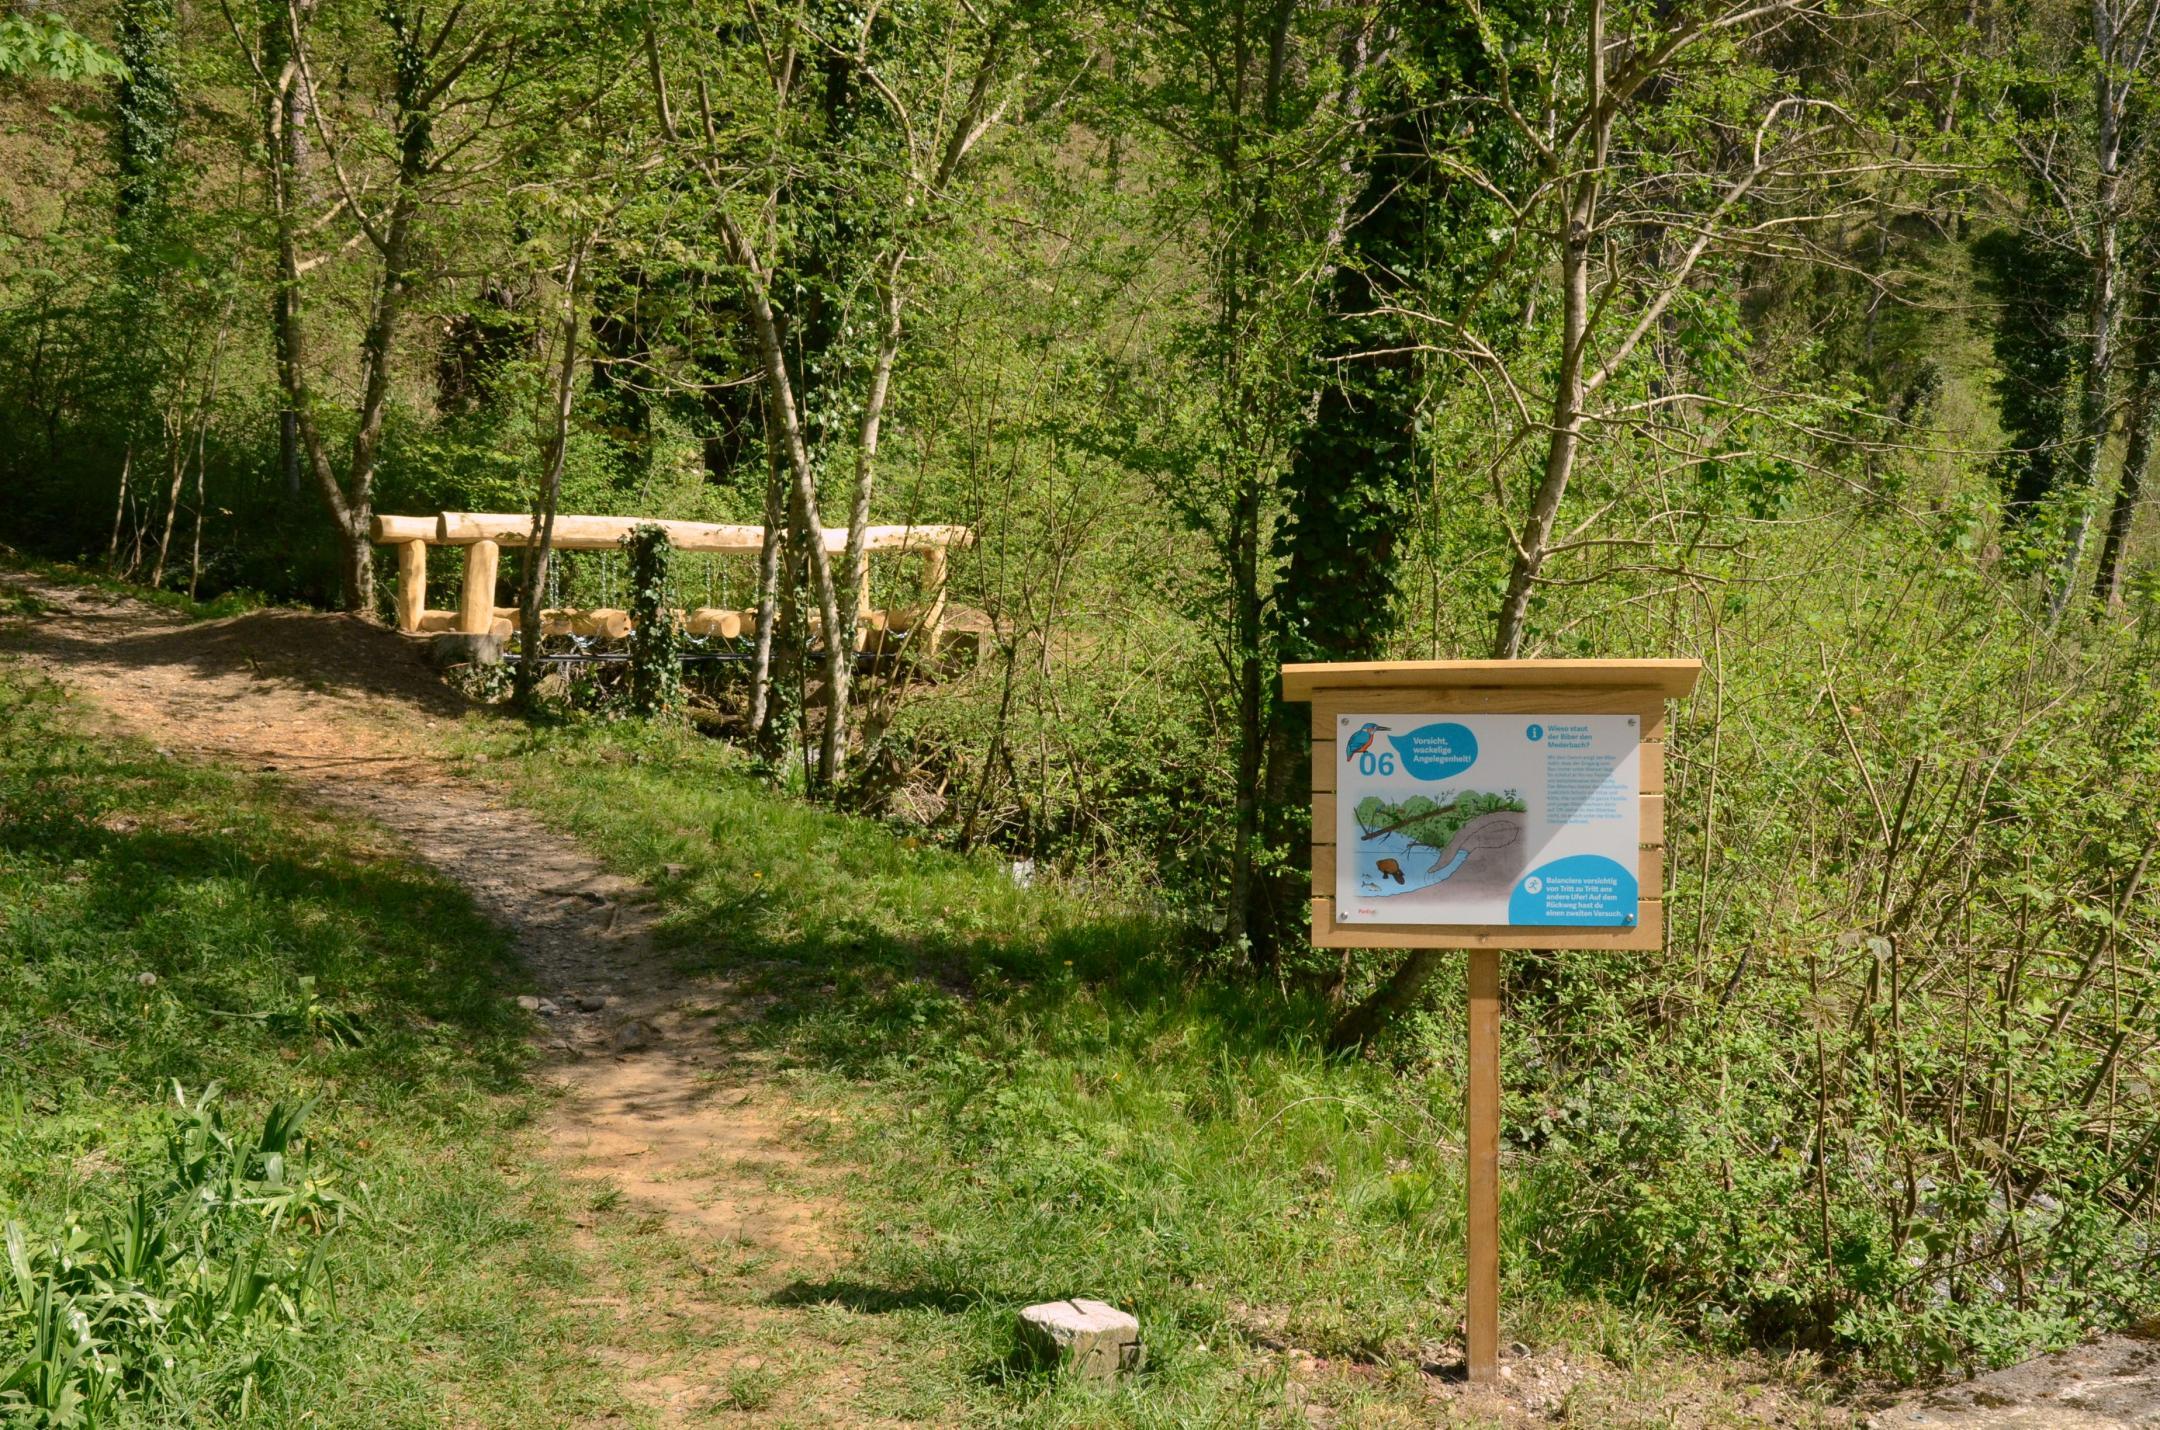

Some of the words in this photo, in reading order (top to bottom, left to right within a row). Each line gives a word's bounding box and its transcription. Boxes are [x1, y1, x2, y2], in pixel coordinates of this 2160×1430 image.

[1413, 737, 1448, 746] Vorsicht,
[1413, 747, 1451, 756] wackelige
[1360, 752, 1395, 776] 06
[1413, 755, 1471, 764] Angelegenheit!
[1584, 877, 1617, 886] vorsichtig
[1546, 901, 1577, 909] Rückweg
